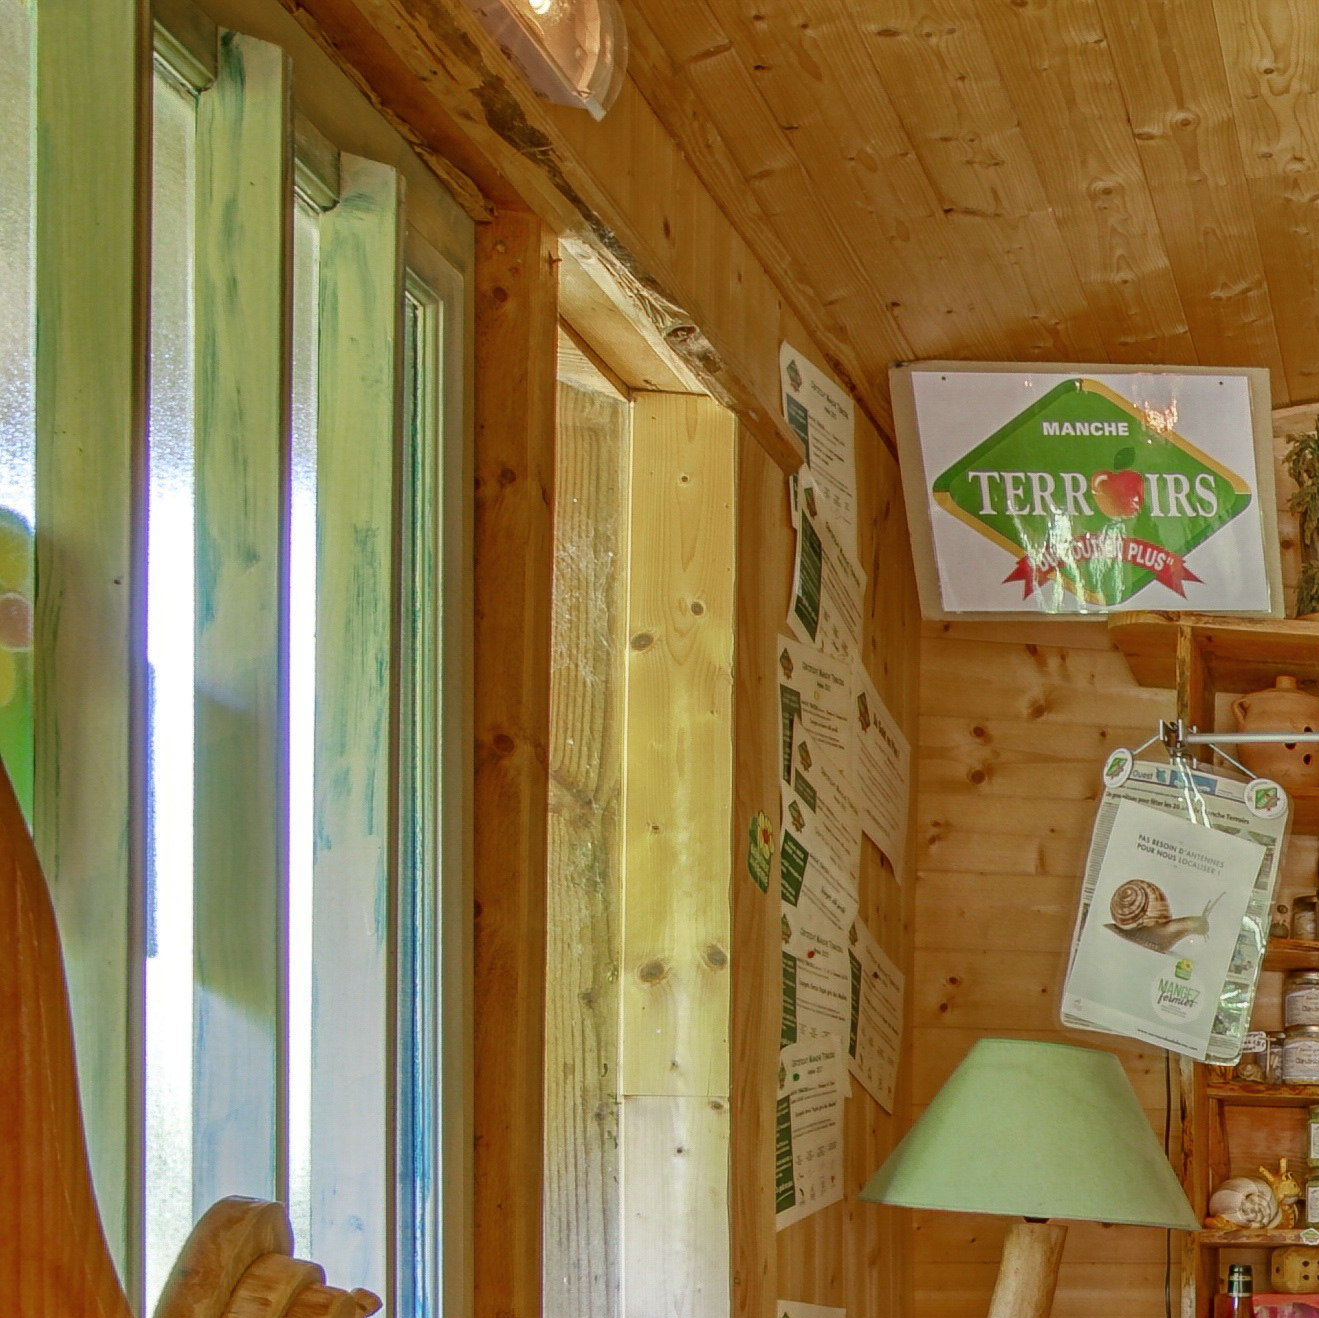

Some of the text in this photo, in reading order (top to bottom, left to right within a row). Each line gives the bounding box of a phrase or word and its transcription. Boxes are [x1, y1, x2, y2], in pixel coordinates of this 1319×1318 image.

[1042, 421, 1130, 437] MANCHE
[1138, 834, 1150, 844] PAS
[1151, 838, 1177, 852] BESOIN
[1137, 843, 1155, 855] POUR
[1156, 850, 1177, 862] NOUS
[1158, 978, 1201, 1000] MANGEZ
